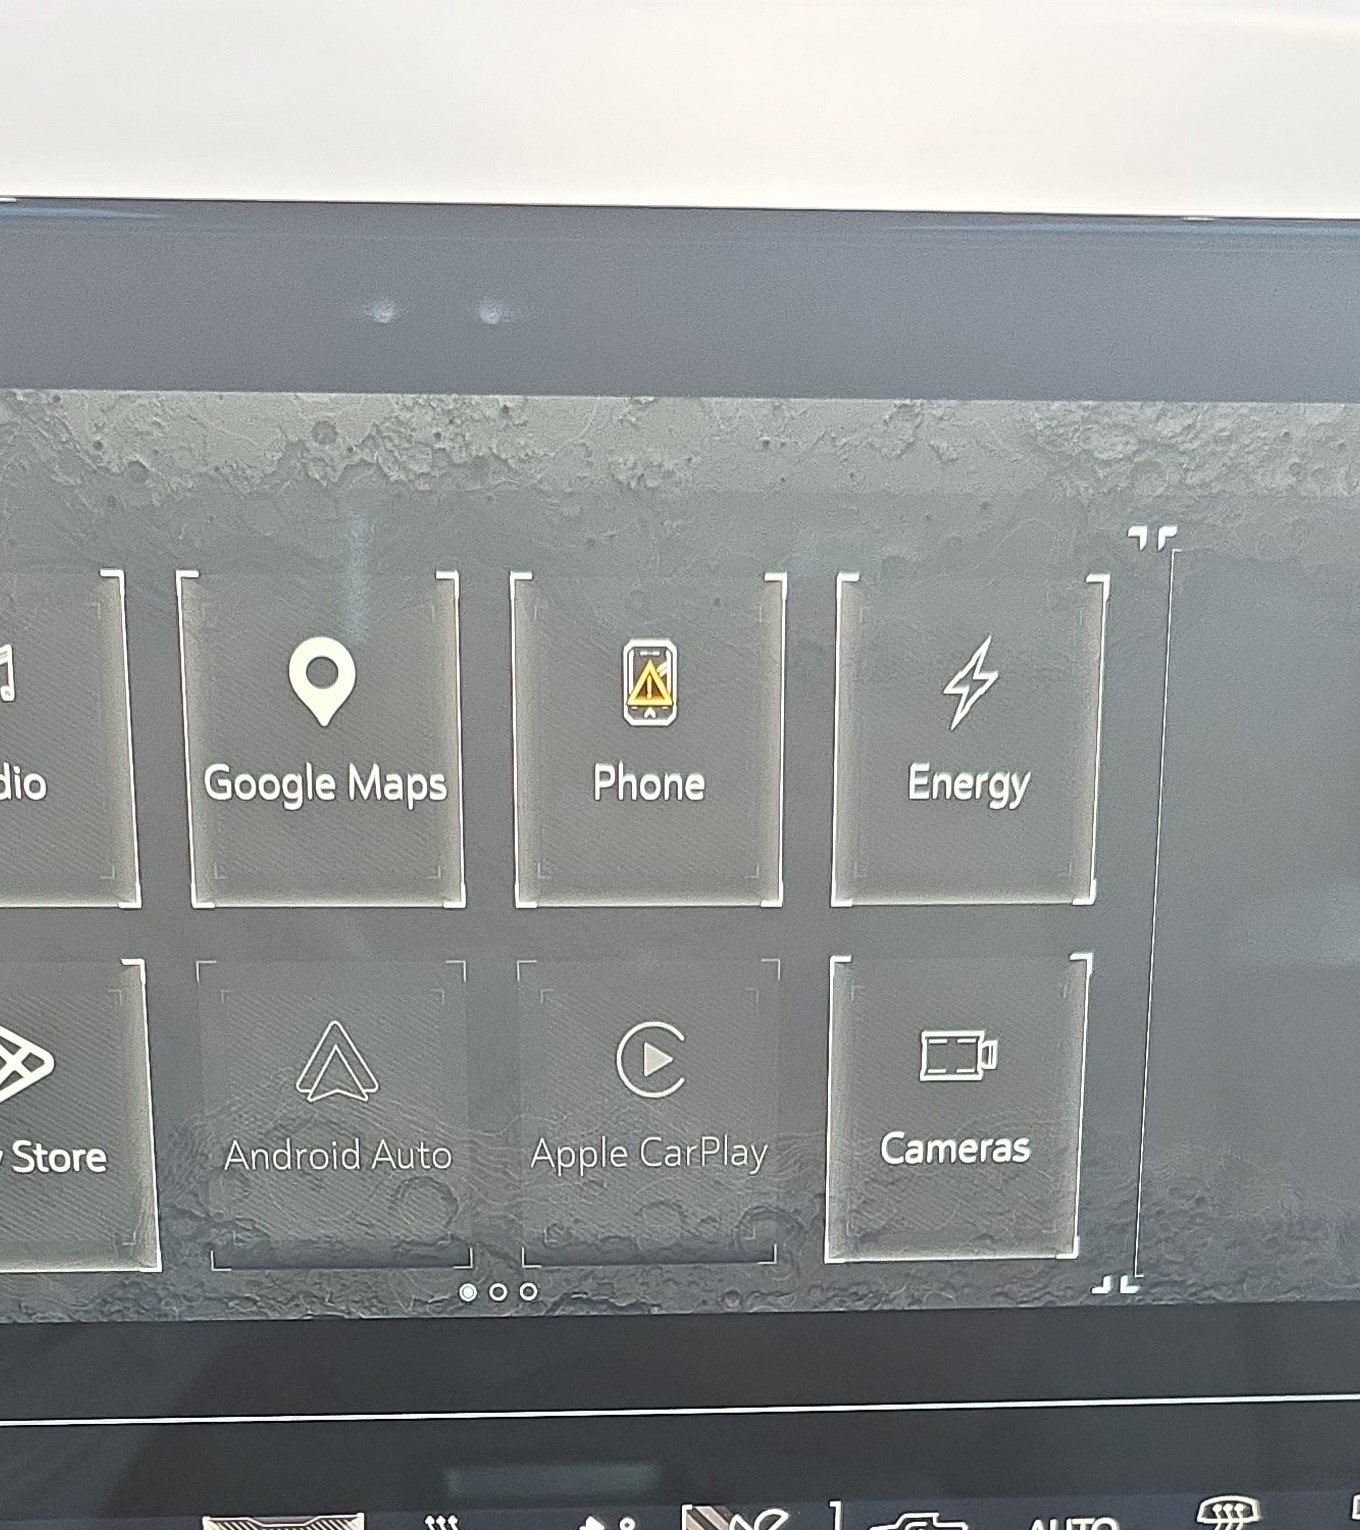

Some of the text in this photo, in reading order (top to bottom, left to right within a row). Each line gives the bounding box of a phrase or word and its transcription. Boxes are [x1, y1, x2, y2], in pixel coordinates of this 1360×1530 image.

[203, 763, 447, 810] Google Maps
[592, 761, 706, 802] Phone
[907, 762, 1032, 810] Energy
[12, 1142, 108, 1174] Store
[223, 1138, 453, 1173] Android Auto
[530, 1135, 769, 1177] Apple CarPlay
[880, 1131, 1031, 1165] Cameras
